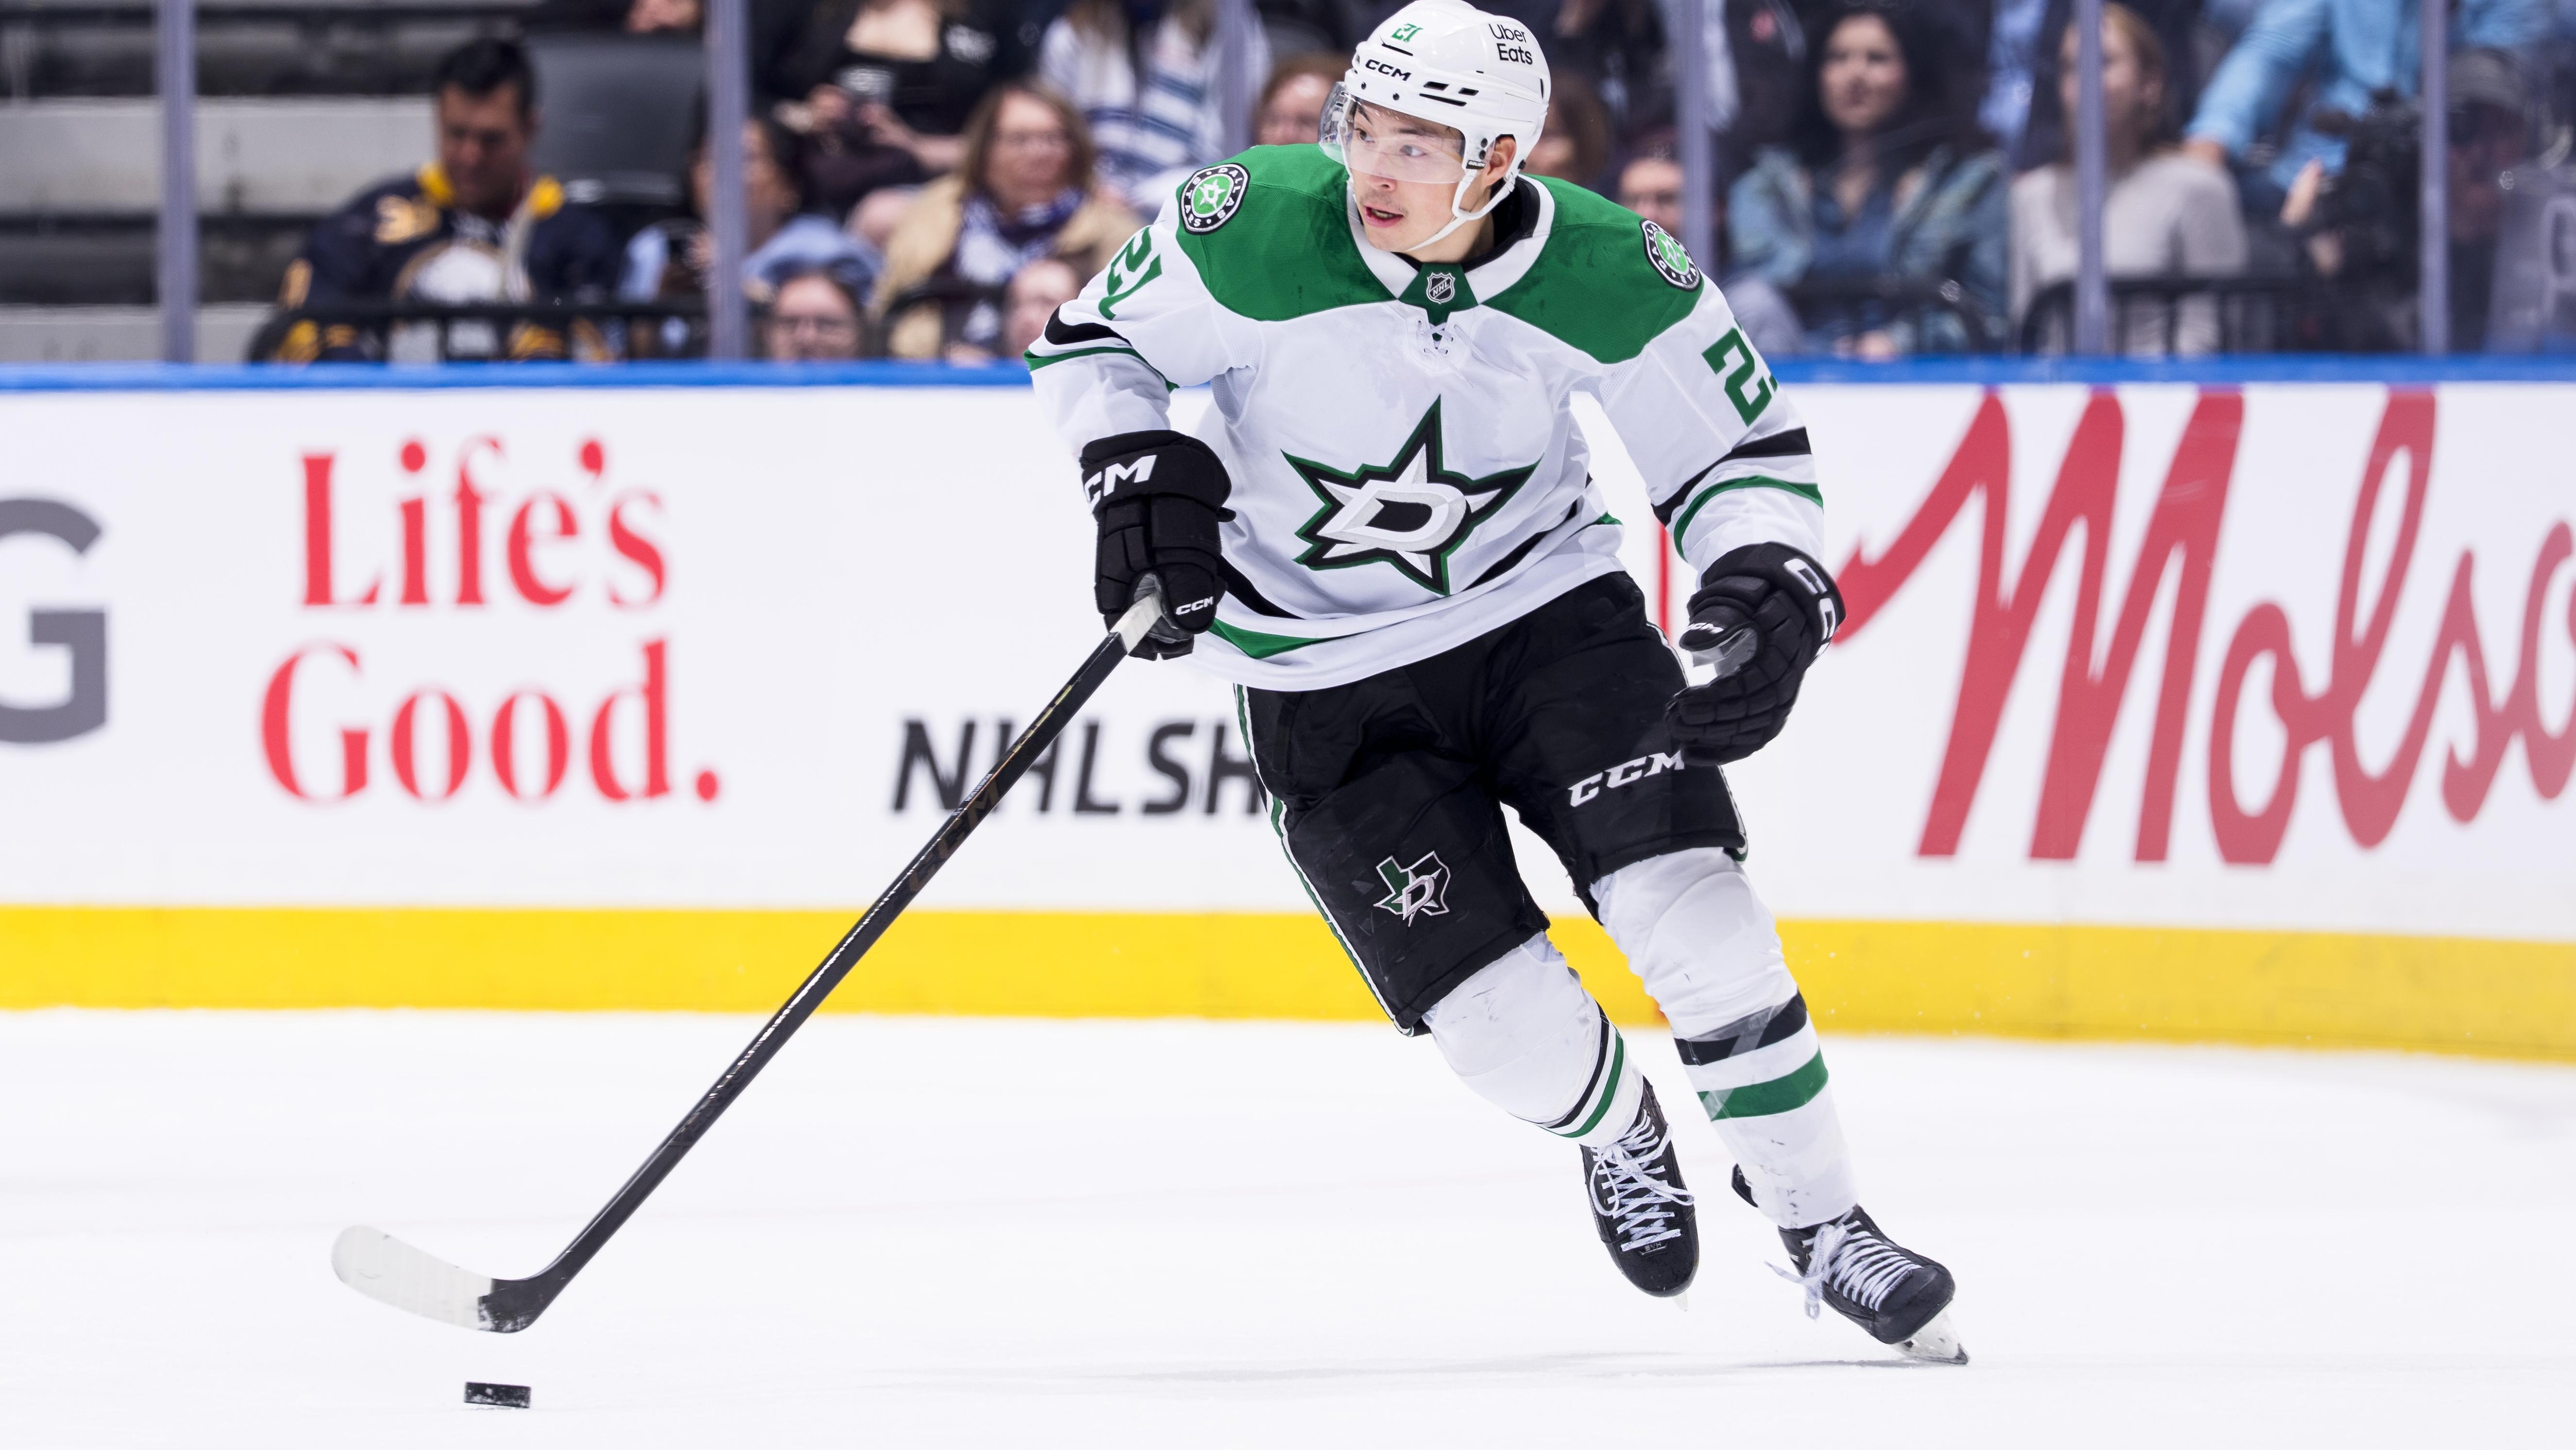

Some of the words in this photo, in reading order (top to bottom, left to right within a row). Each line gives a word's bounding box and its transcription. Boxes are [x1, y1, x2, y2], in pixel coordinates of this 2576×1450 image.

[1391, 23, 1423, 42] 21
[1489, 24, 1526, 43] Uber
[1497, 43, 1533, 65] Eats
[1365, 59, 1411, 81] CCM
[1185, 177, 1201, 227] STARS
[1217, 167, 1243, 219] DALLAS
[1433, 281, 1450, 297] NHL
[1701, 316, 1778, 427] 2
[301, 434, 666, 607] Life's
[0, 498, 107, 744] G
[1175, 596, 1214, 615] CCM
[261, 640, 720, 803] Good.
[1568, 750, 1684, 807] CCM
[908, 777, 1002, 892] CCM
